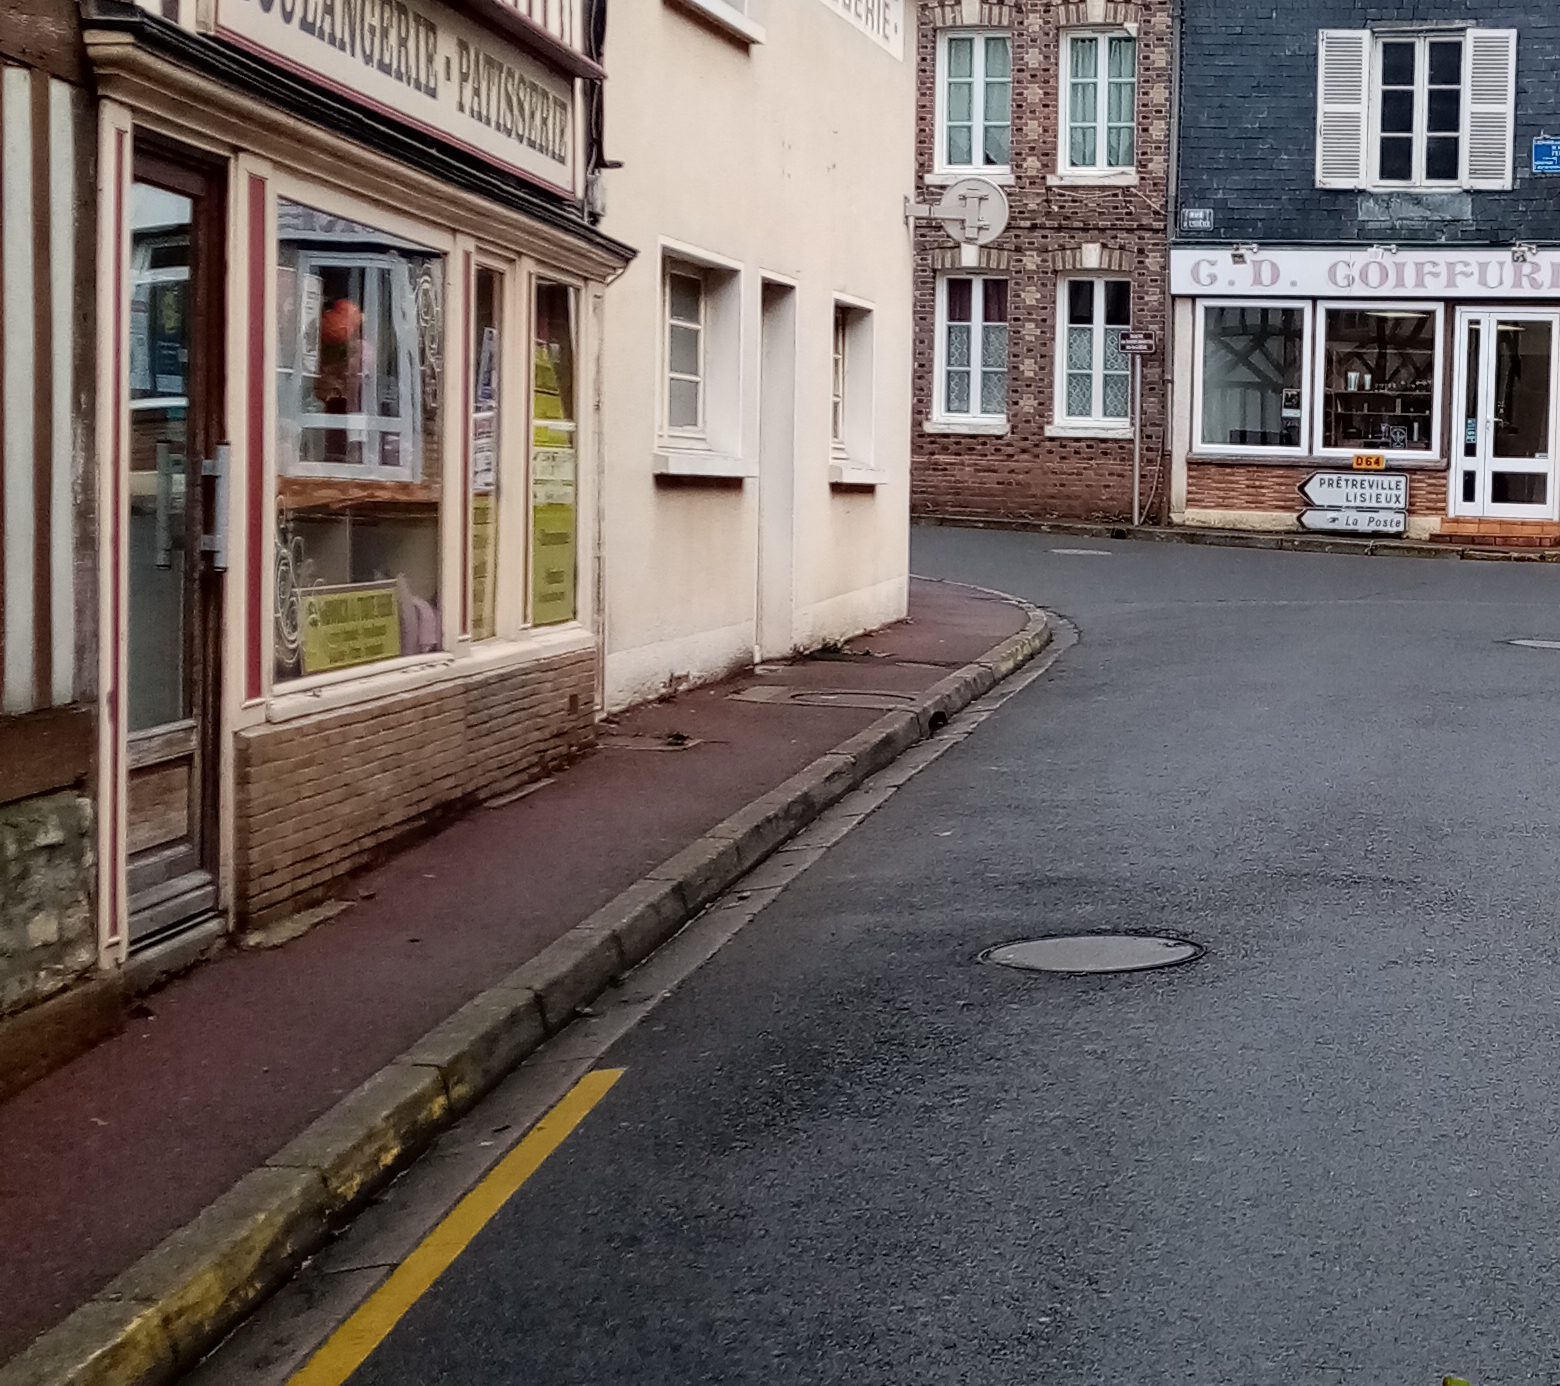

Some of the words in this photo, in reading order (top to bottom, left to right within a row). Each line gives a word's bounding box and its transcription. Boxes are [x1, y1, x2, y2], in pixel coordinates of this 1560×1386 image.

[456, 36, 568, 166] PATISSERIE
[1319, 476, 1403, 491] PRÊTREVILLE
[1345, 492, 1402, 505] LISIEUX
[1345, 515, 1359, 527] La
[1367, 516, 1402, 528] Poste
